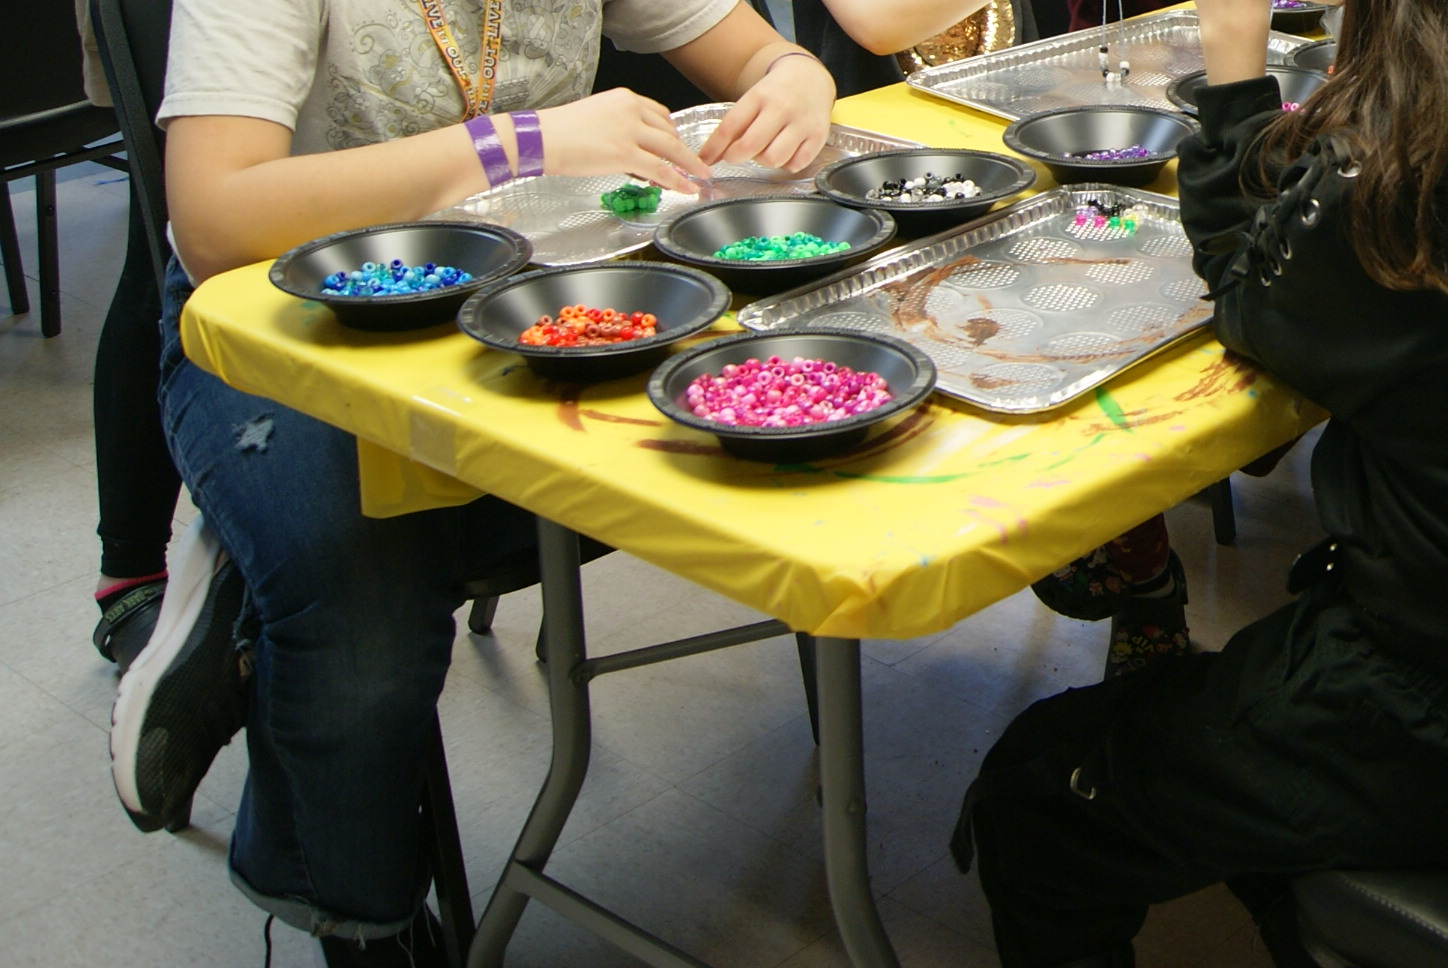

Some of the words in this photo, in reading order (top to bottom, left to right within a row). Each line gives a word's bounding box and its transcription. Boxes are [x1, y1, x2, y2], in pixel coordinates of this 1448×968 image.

[485, 0, 502, 38] LIVE
[446, 46, 469, 77] OUT
[483, 45, 498, 80] OUT
